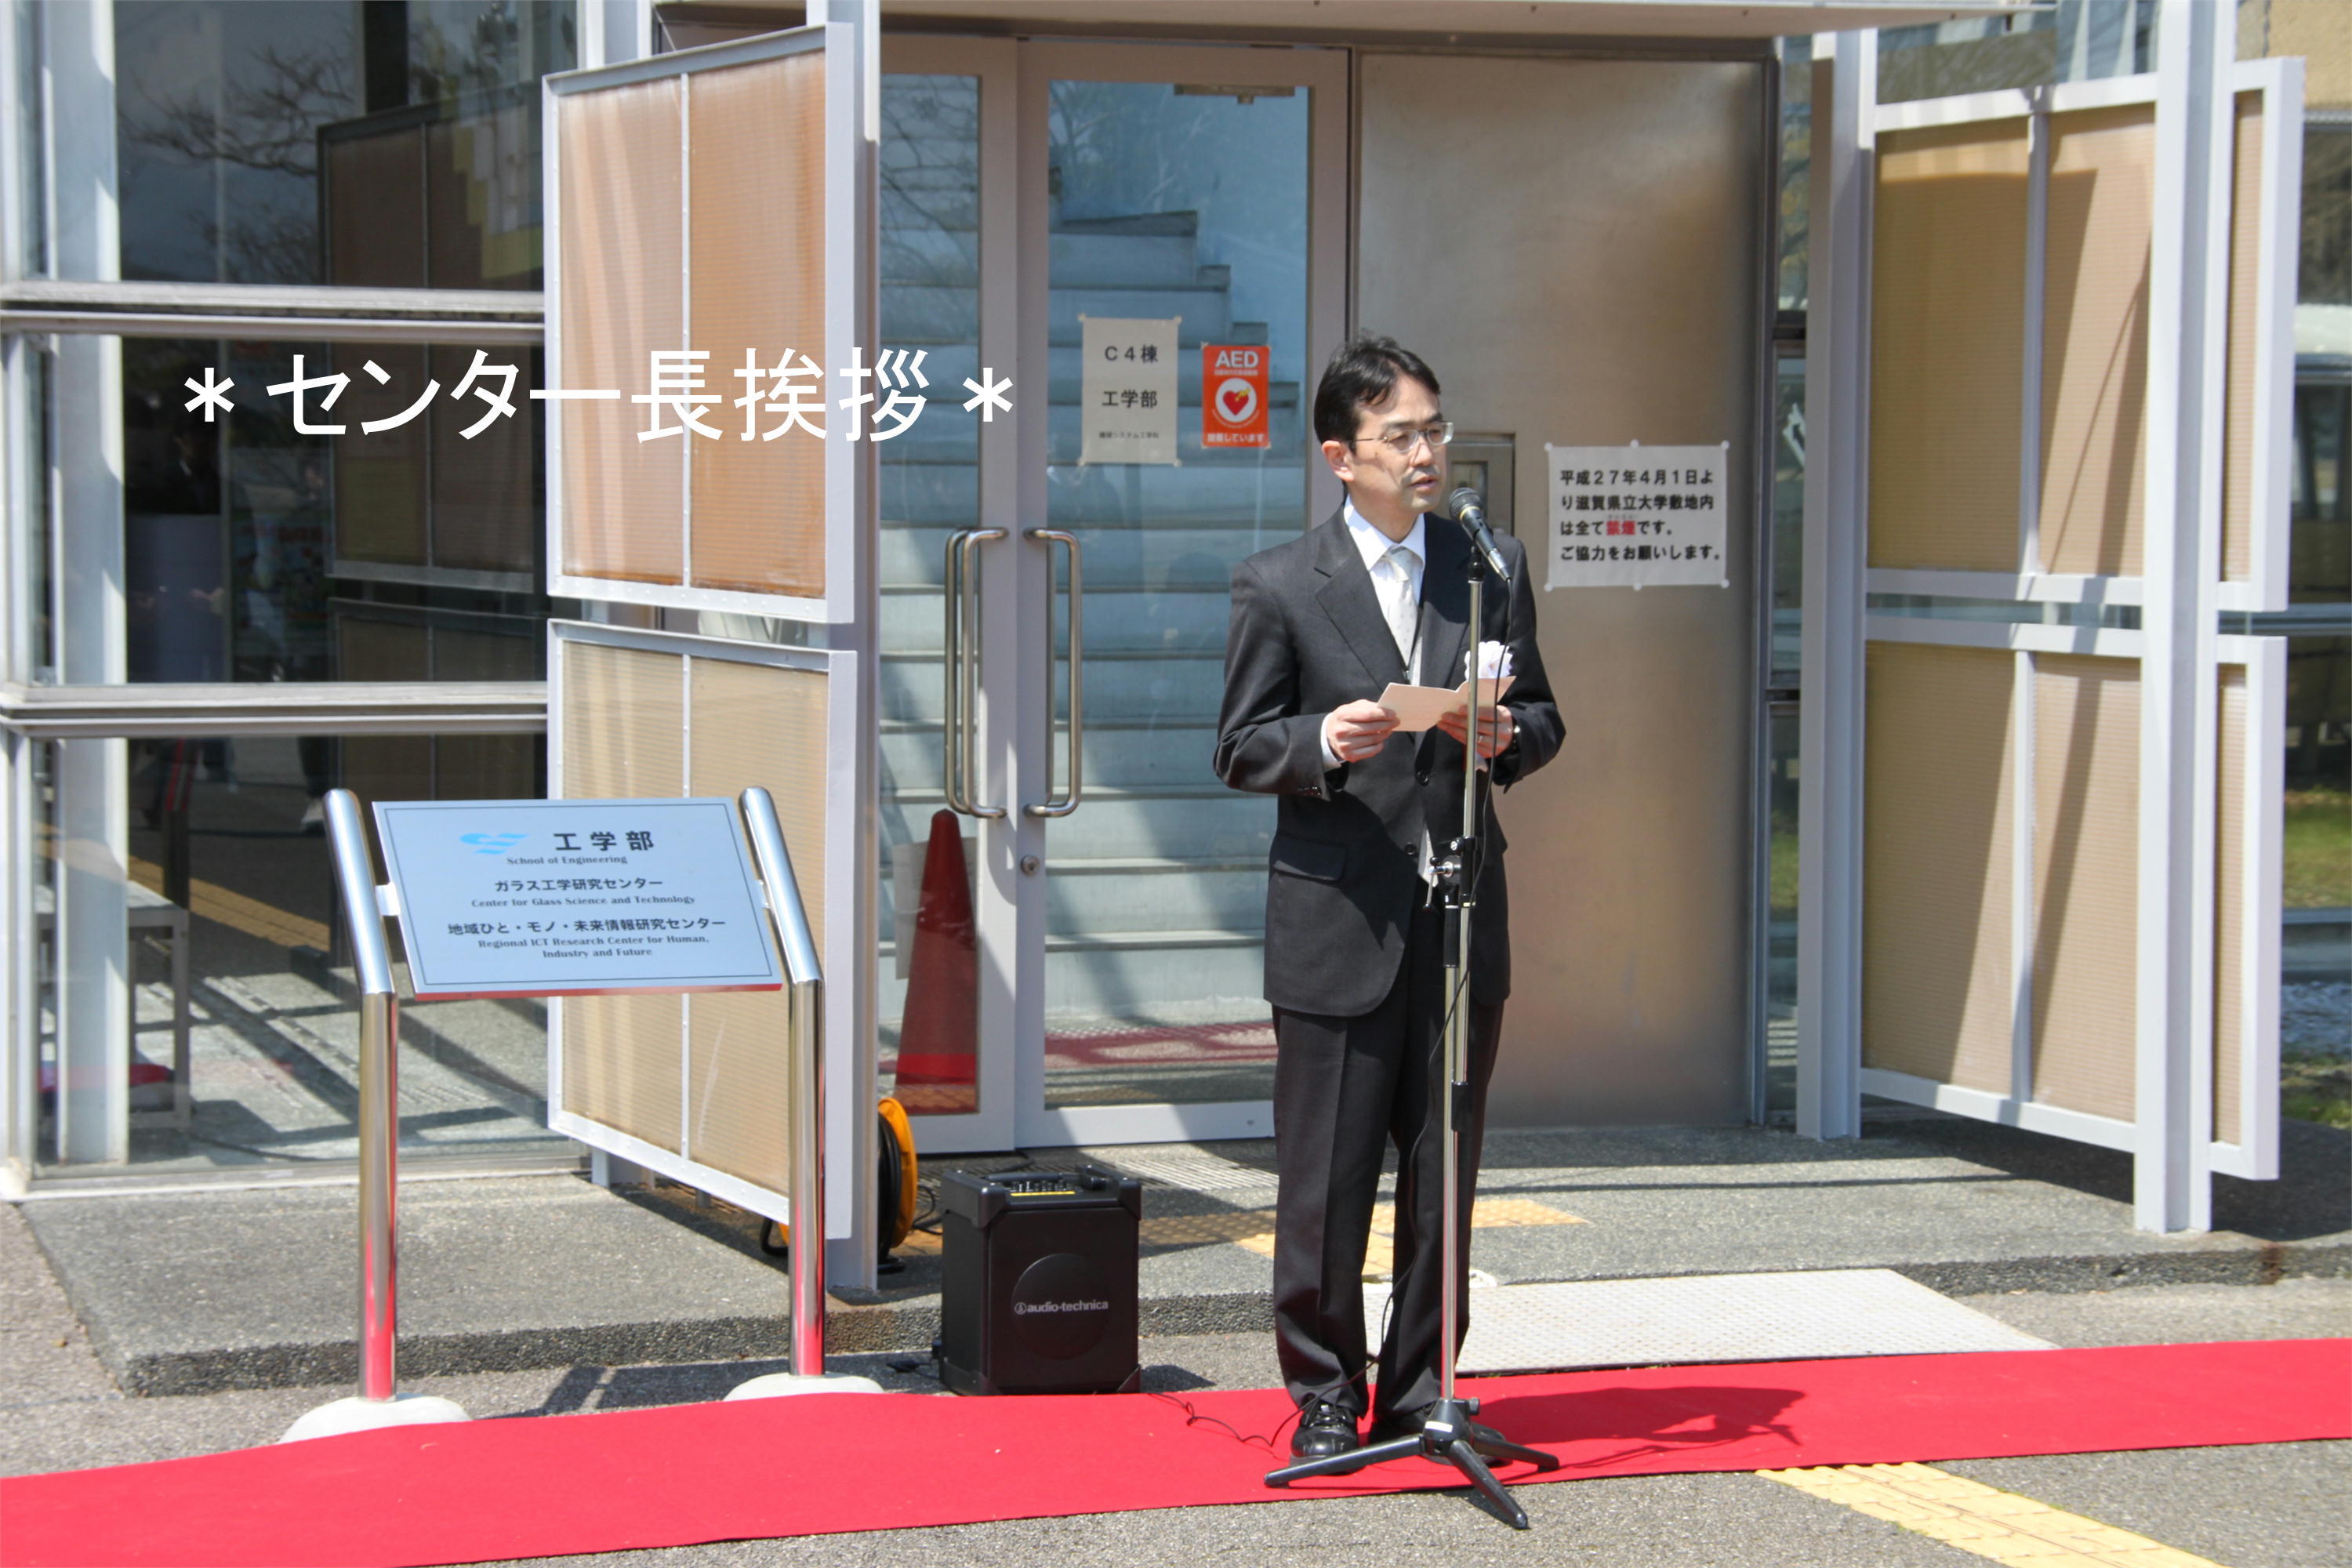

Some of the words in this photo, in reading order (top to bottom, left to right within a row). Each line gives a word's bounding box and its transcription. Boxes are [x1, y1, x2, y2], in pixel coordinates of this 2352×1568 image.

[1104, 345, 1159, 364] C4棟
[1215, 350, 1259, 368] AED
[1102, 389, 1159, 409] 工学部
[1560, 470, 1714, 485] 平成27年4月1日よ
[1561, 494, 1715, 511] り滋賀県立大学敷地内
[1560, 545, 1720, 561] ご協力をお願いします。
[553, 830, 655, 852] 工学部
[561, 855, 628, 866] Engineering
[494, 877, 663, 891] ガラス工学研究センター
[471, 898, 508, 908] Center
[512, 898, 528, 906] for
[532, 898, 562, 906] Glass
[564, 897, 607, 906] Science
[611, 896, 631, 905] and
[634, 895, 695, 905] Technology
[448, 917, 727, 935] 地域ひと・モノ・未来情報研究センター
[477, 939, 528, 949] Regional
[553, 937, 604, 946] Research
[608, 936, 643, 945] Center
[647, 935, 662, 944] for
[543, 950, 589, 959] Industry
[593, 949, 613, 957] and
[616, 948, 652, 956] Future
[1027, 1300, 1109, 1313] audio-technica
